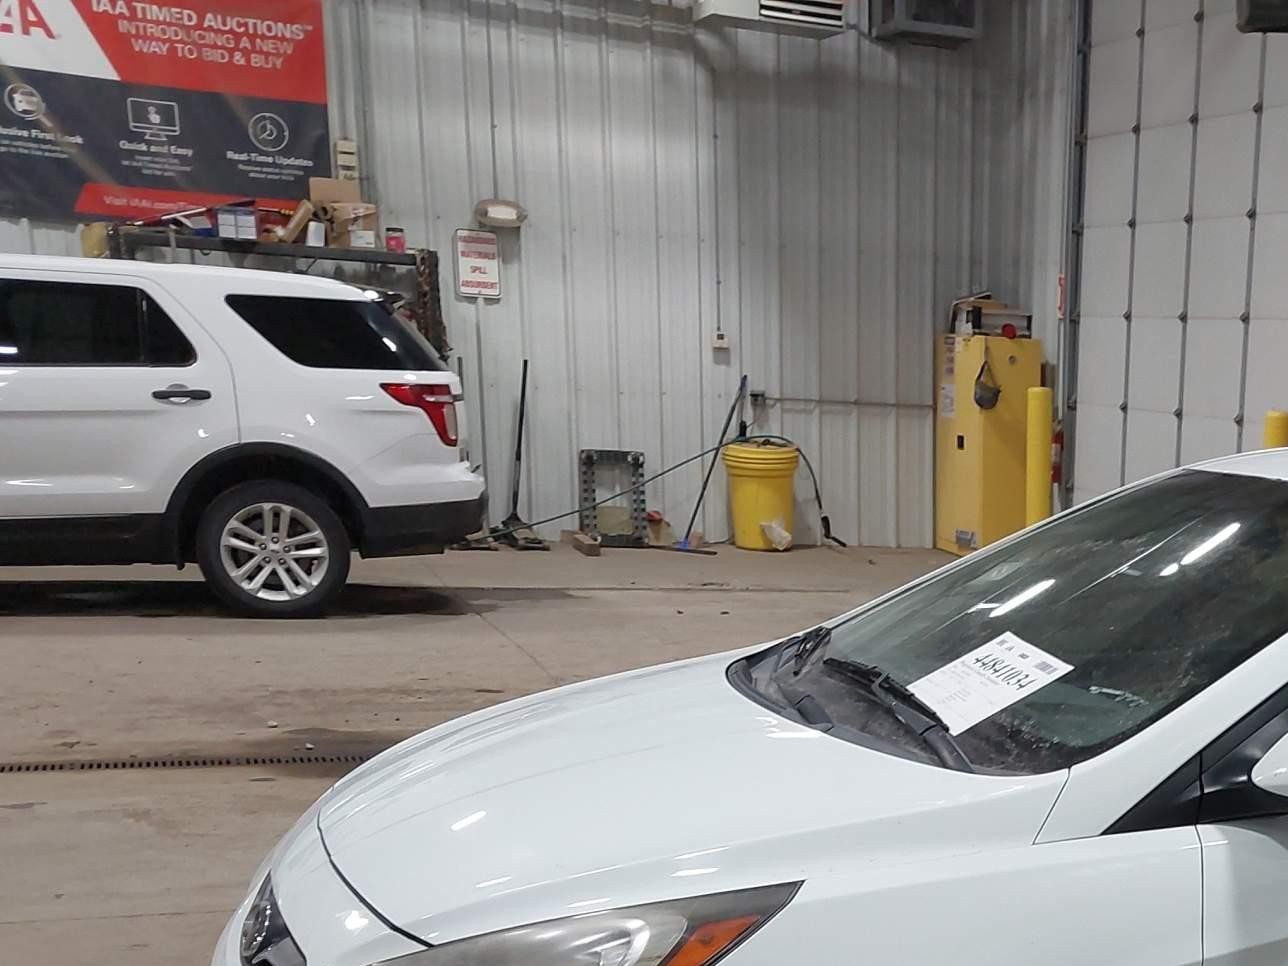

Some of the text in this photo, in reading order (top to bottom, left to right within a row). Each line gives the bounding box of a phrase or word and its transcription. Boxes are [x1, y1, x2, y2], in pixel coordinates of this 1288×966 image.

[92, 0, 129, 17] IAA
[132, 3, 198, 26] TIMED
[118, 20, 294, 54] INTRODUCING A NEW
[131, 38, 284, 70] WAY TO BID & BUY
[119, 140, 193, 157] Quick and Easy
[226, 150, 314, 167] Real-Time Updates
[470, 265, 488, 275] SPILL
[972, 653, 1039, 691] 44841034
